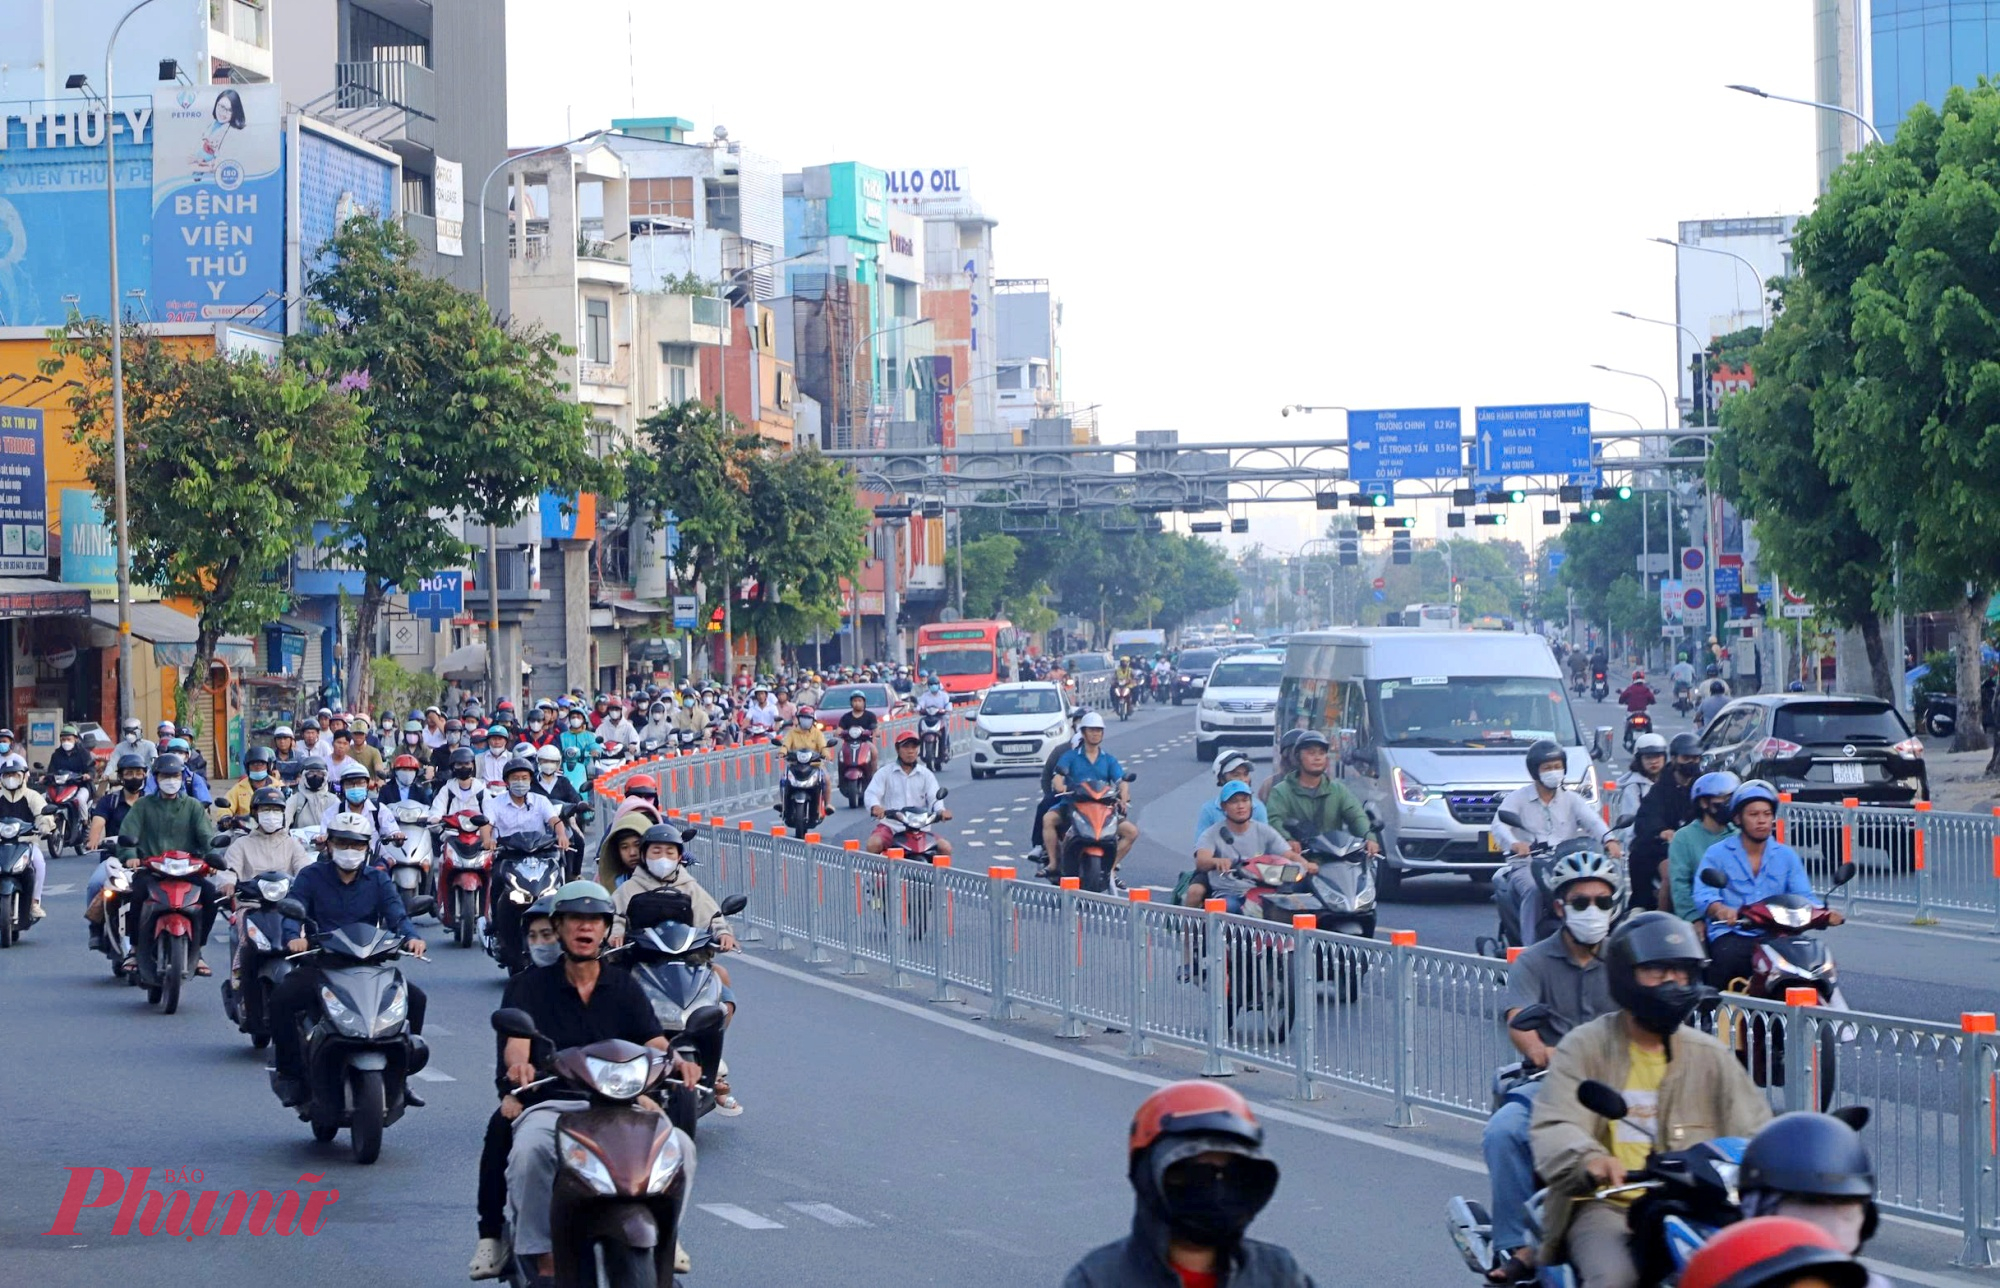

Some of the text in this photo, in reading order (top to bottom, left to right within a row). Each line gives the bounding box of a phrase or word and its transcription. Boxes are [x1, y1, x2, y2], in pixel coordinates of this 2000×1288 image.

[930, 169, 961, 192] OIL
[175, 189, 257, 221] BỆNH
[181, 220, 253, 251] VIỆN
[186, 250, 247, 276] THÚ
[207, 281, 226, 300] Y
[166, 311, 197, 323] 24/7
[1478, 406, 1584, 420] CẢNG HÀNG KHÔNG TÂN SƠN NHẤT
[1, 415, 37, 430] SX TM DV
[1375, 420, 1403, 431] TRƯỜNG
[1445, 420, 1457, 429] Km
[1571, 427, 1577, 435] 2
[1578, 426, 1589, 434] Km
[3, 436, 36, 456] TRUNG
[1389, 445, 1412, 454] TRỌNG
[1446, 443, 1457, 452] Km
[1518, 446, 1532, 454] GIAO
[1446, 467, 1458, 475] Km
[1502, 461, 1511, 469] AN
[1572, 459, 1577, 467] 5
[1578, 459, 1589, 467] Km
[72, 523, 113, 557] MINH
[418, 575, 457, 592] HÚ-Y
